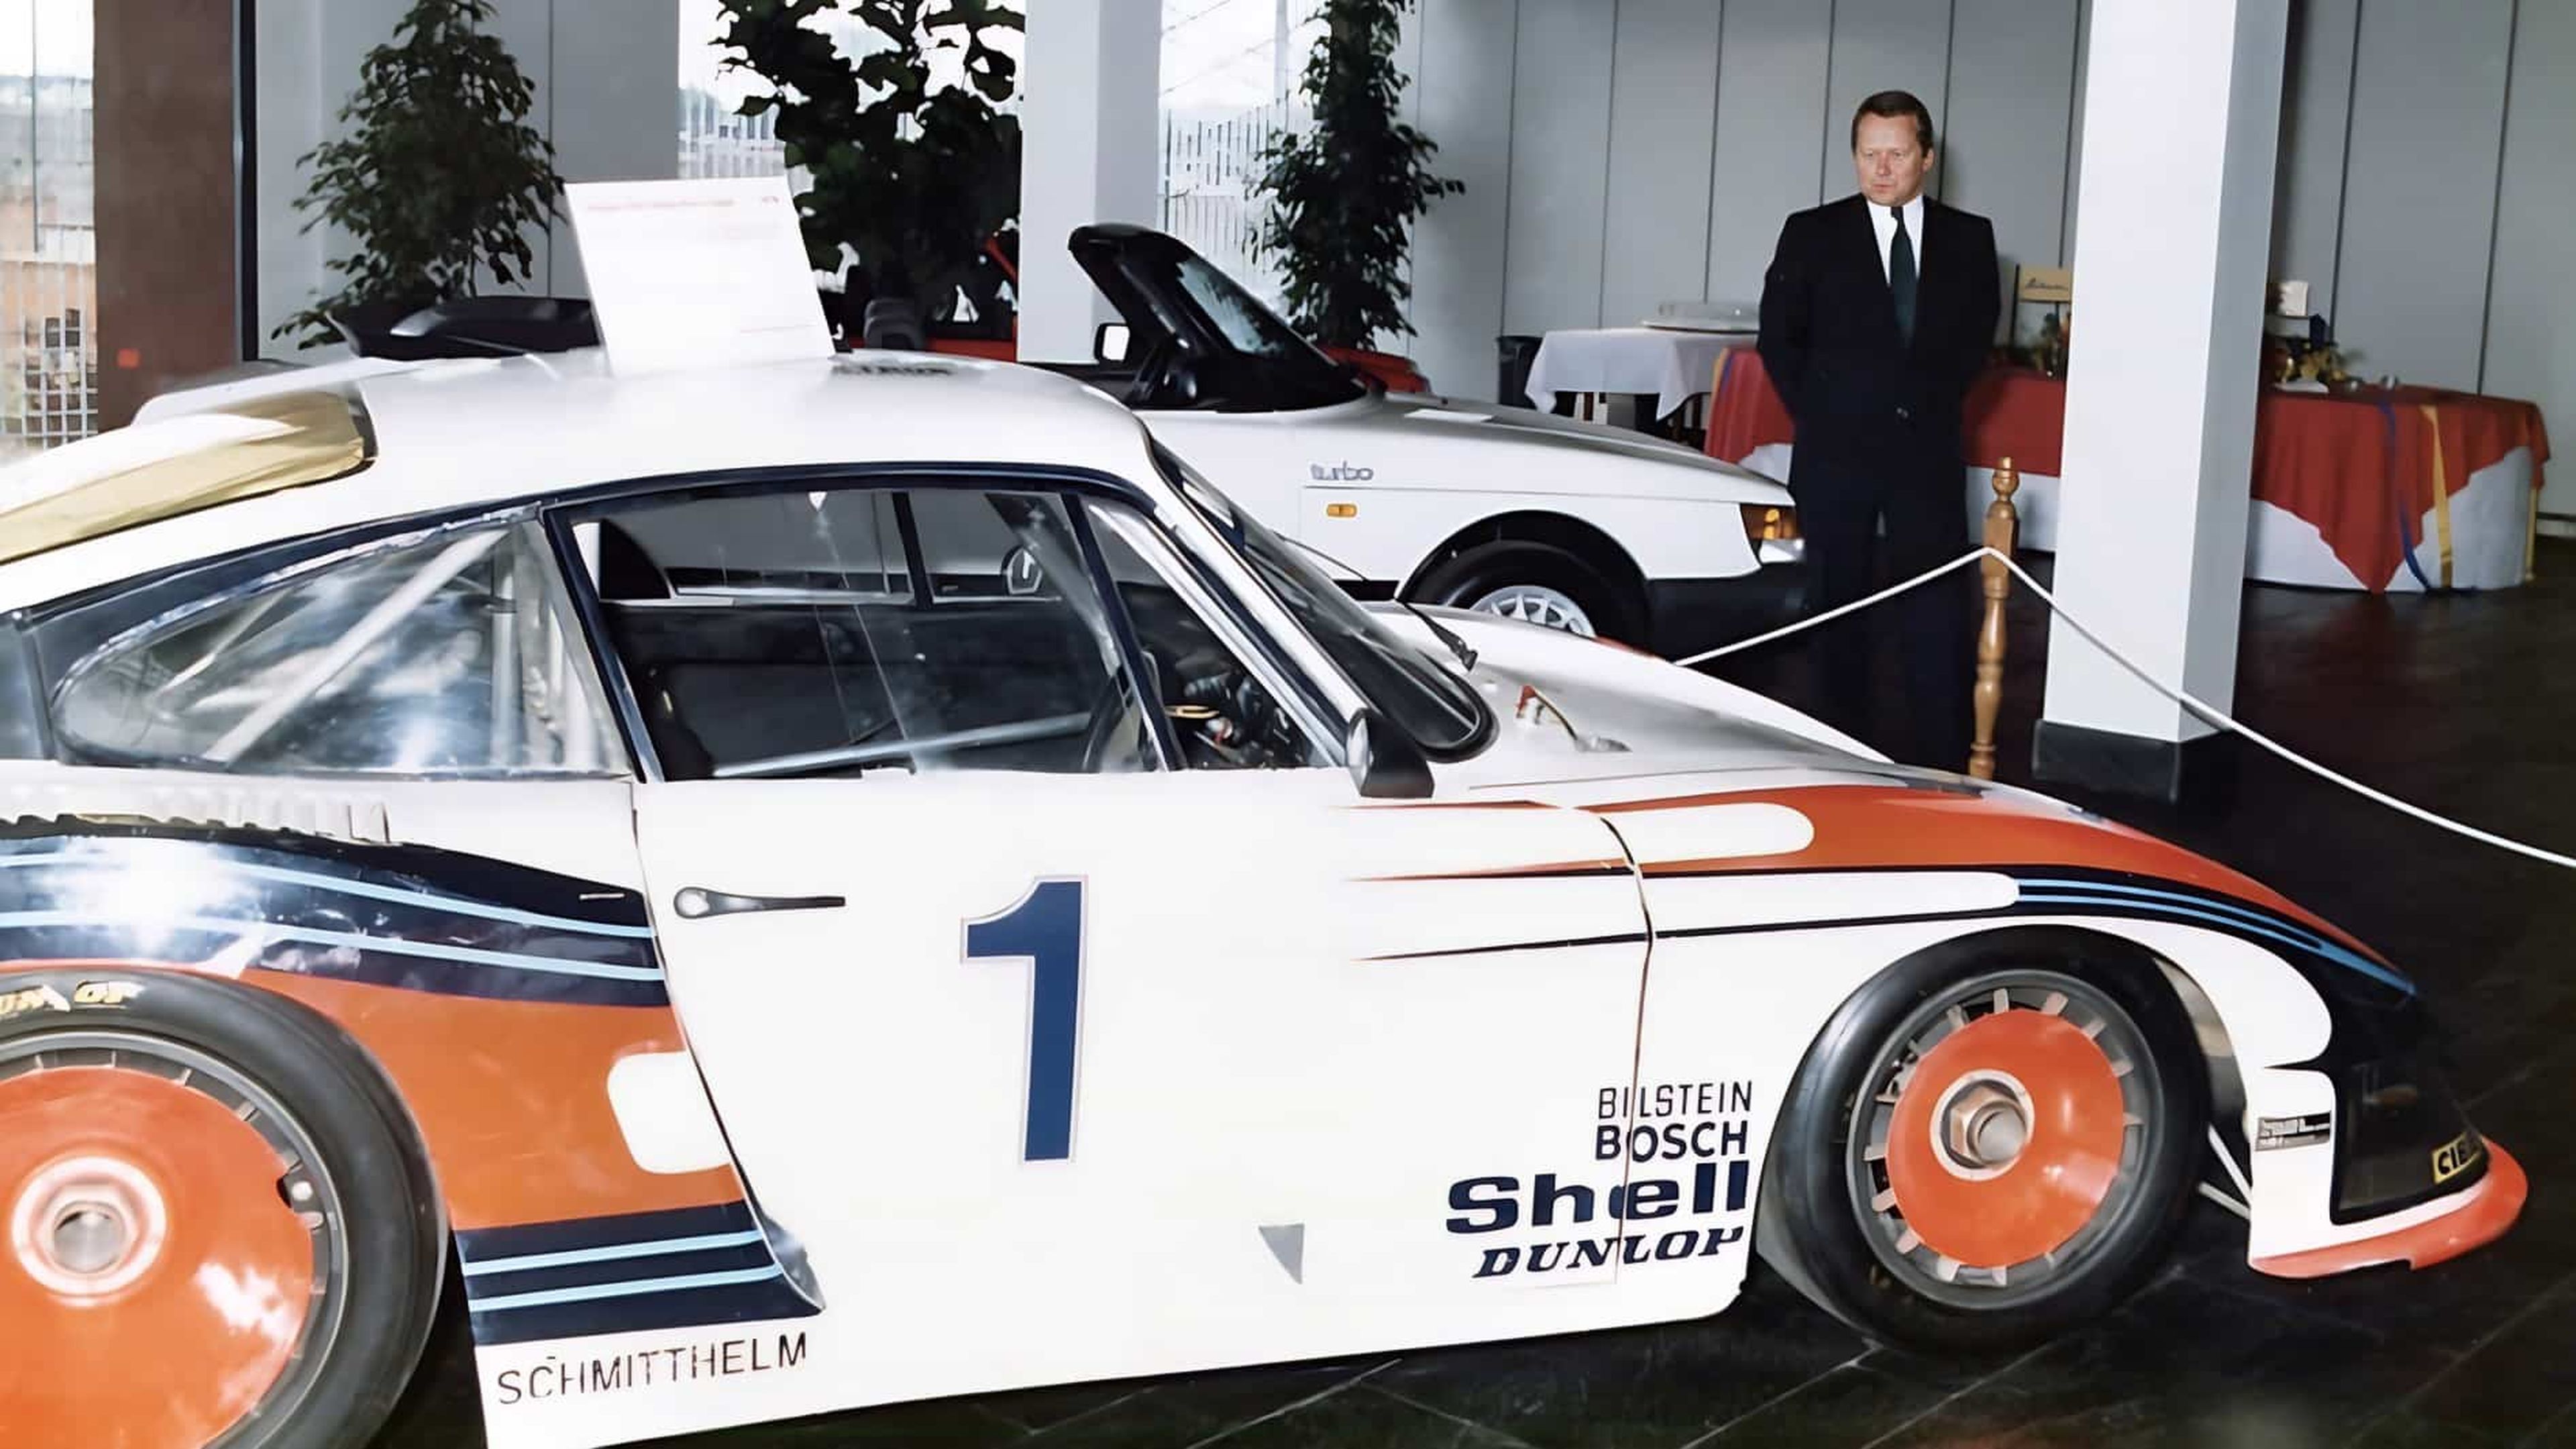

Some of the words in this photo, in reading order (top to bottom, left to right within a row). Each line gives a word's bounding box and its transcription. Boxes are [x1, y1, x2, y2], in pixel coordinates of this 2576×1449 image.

[961, 874, 1087, 1164] 1
[1599, 1080, 1752, 1119] BILSTEIN
[1595, 1120, 1748, 1163] BOSCH
[1446, 1159, 1750, 1234] Shell
[1471, 1226, 1744, 1279] DUNLOP
[497, 1332, 806, 1405] SCHMITTHELM
